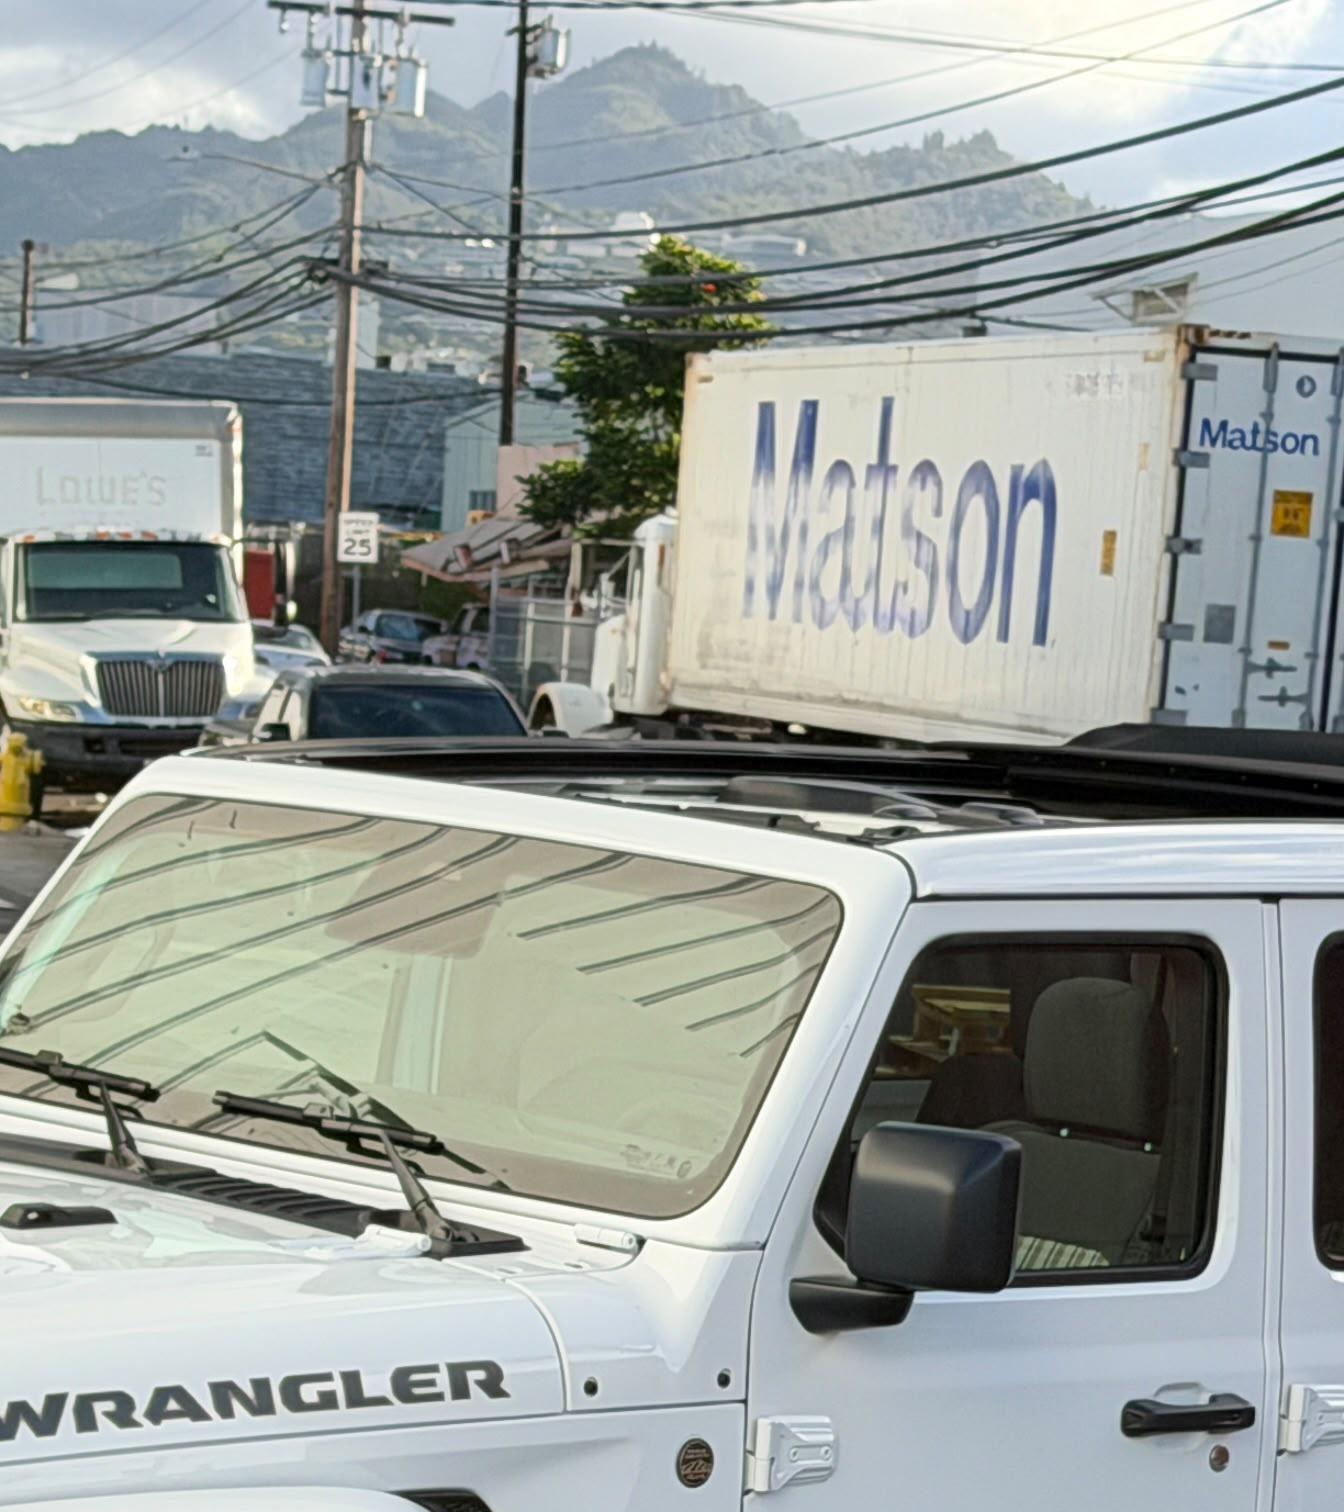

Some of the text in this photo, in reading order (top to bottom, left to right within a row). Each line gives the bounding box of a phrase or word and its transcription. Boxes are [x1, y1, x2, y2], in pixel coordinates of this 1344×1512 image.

[1198, 417, 1321, 457] Matson
[740, 396, 1058, 648] Matson
[343, 538, 372, 557] 25
